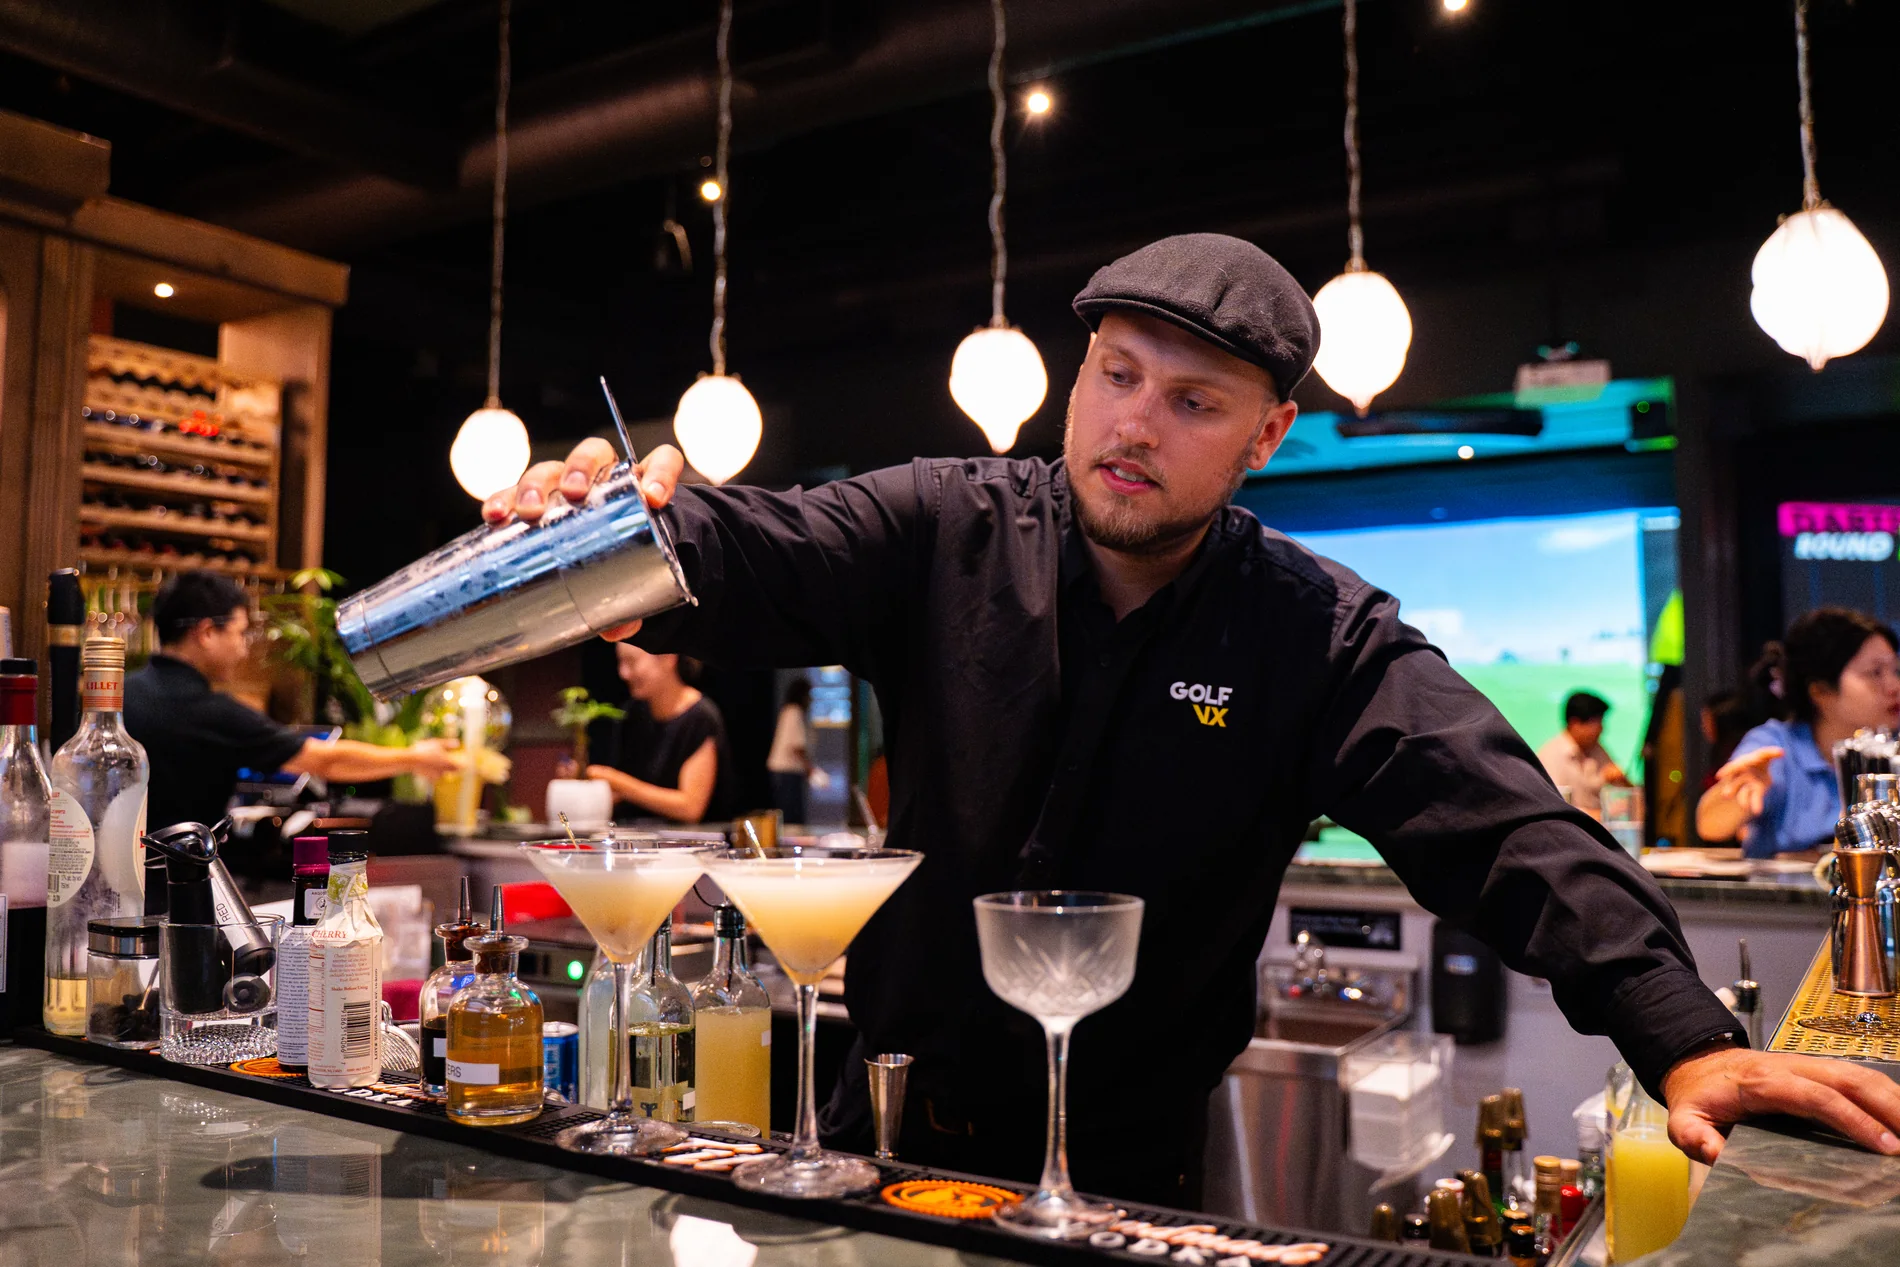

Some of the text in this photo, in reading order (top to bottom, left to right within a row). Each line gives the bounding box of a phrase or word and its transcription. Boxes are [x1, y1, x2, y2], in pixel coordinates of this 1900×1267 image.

[85, 681, 118, 690] LILLET
[1169, 681, 1233, 706] GOLF
[1192, 703, 1229, 728] VX
[215, 902, 232, 923] RED
[311, 929, 348, 939] CHERRY
